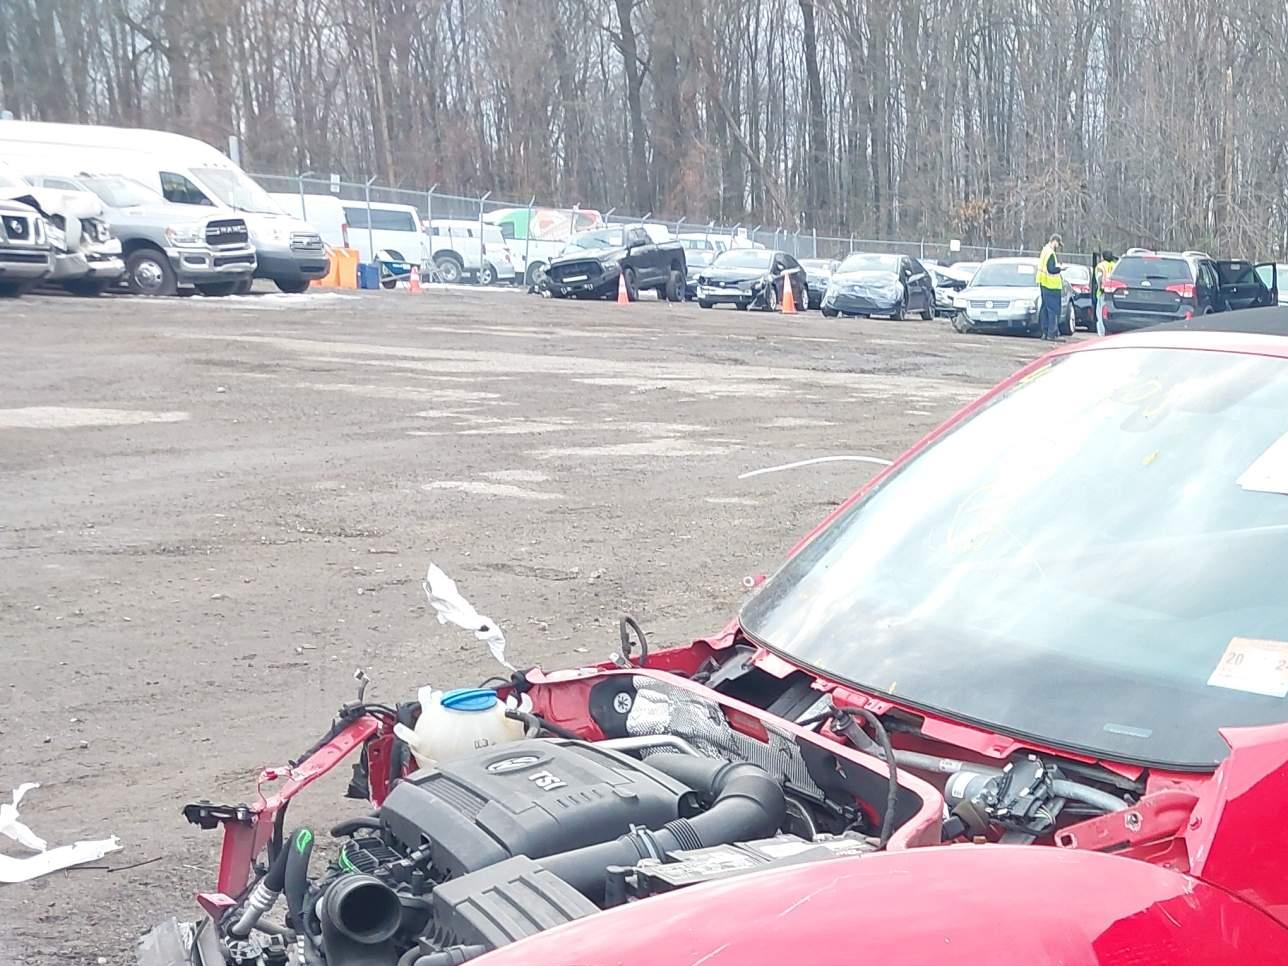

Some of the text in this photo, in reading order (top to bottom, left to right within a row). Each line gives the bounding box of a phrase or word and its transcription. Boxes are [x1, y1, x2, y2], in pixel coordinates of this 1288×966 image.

[219, 224, 242, 235] RAM
[1224, 651, 1245, 666] 20
[527, 770, 569, 792] TSI
